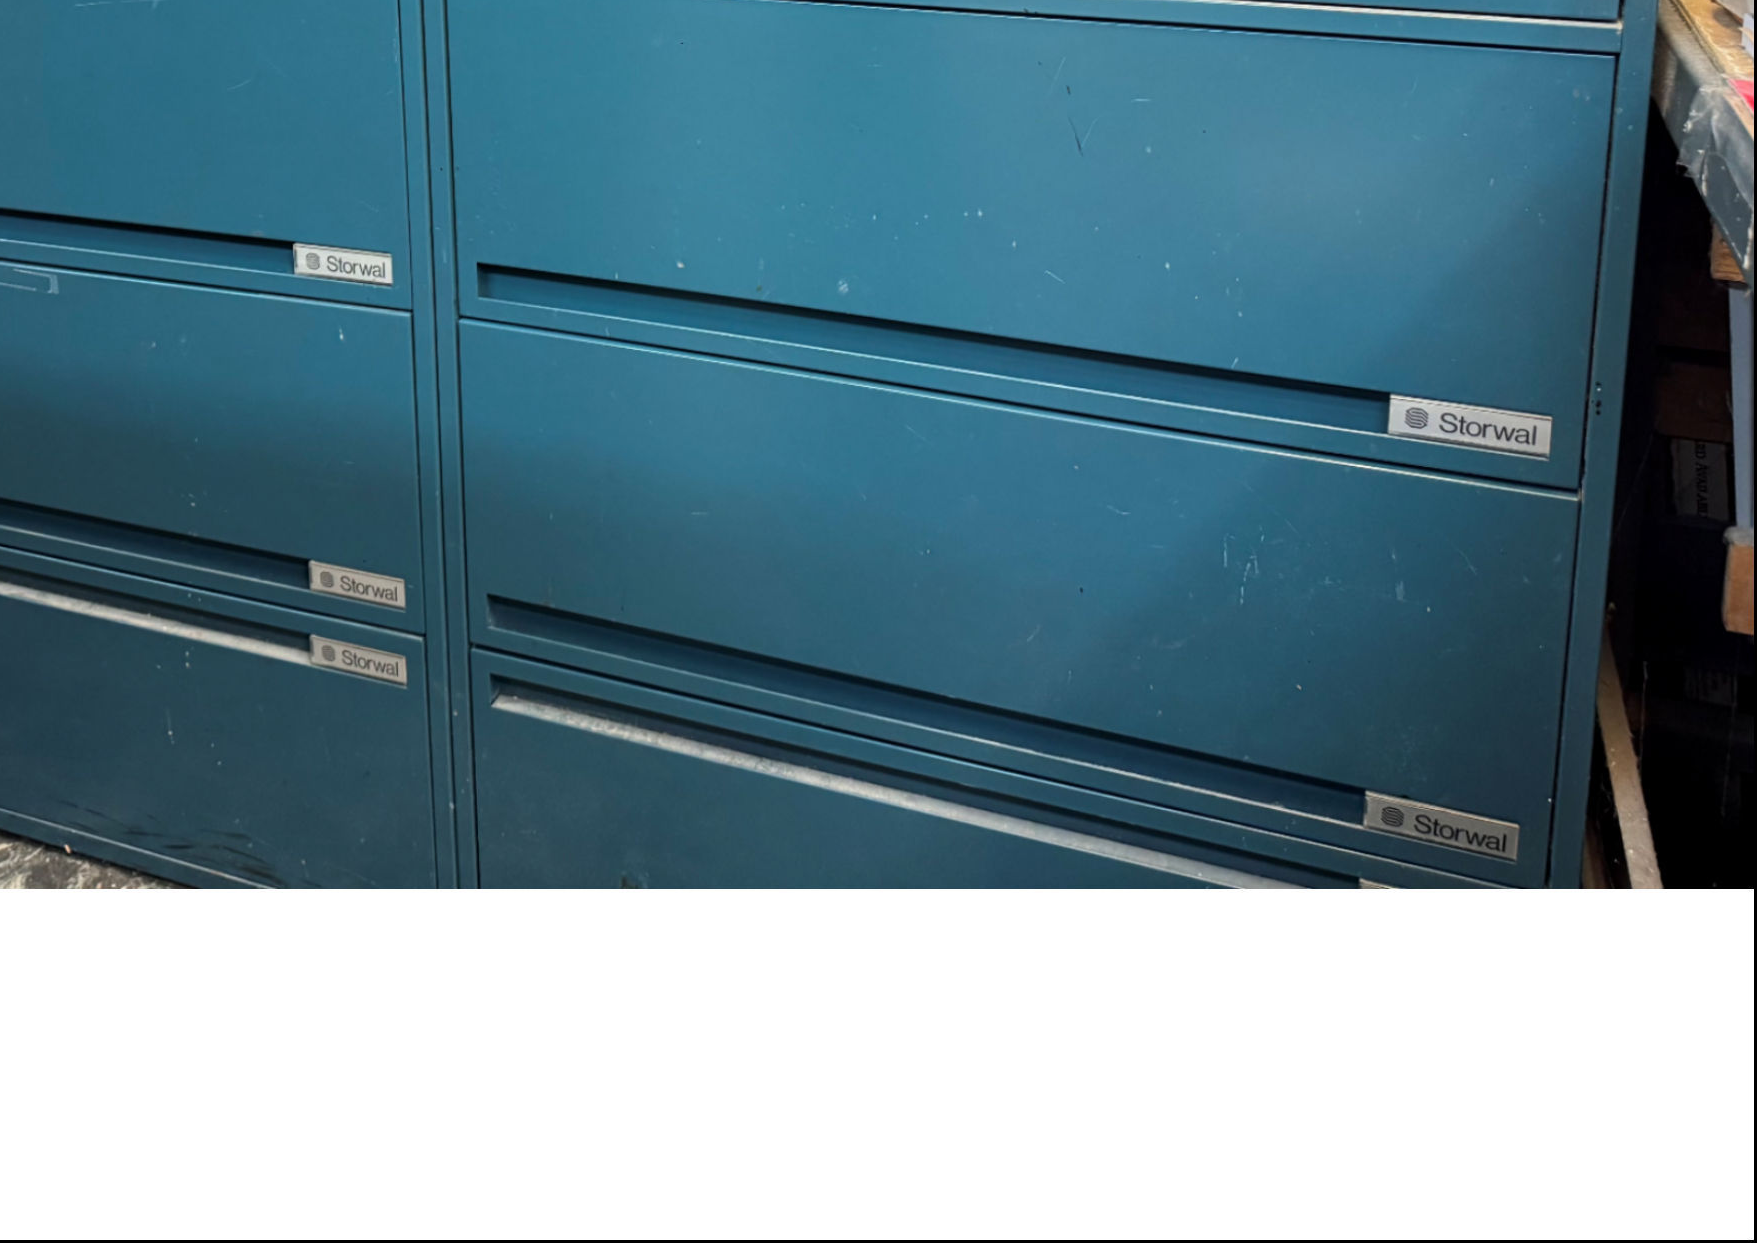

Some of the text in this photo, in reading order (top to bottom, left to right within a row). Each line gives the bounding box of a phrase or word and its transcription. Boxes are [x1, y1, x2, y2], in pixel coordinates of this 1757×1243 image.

[326, 255, 387, 279] Storwal
[1438, 412, 1538, 447] Storwal
[339, 575, 399, 602] Storwal
[341, 649, 400, 678] Storwal
[1413, 814, 1508, 853] Storwal
